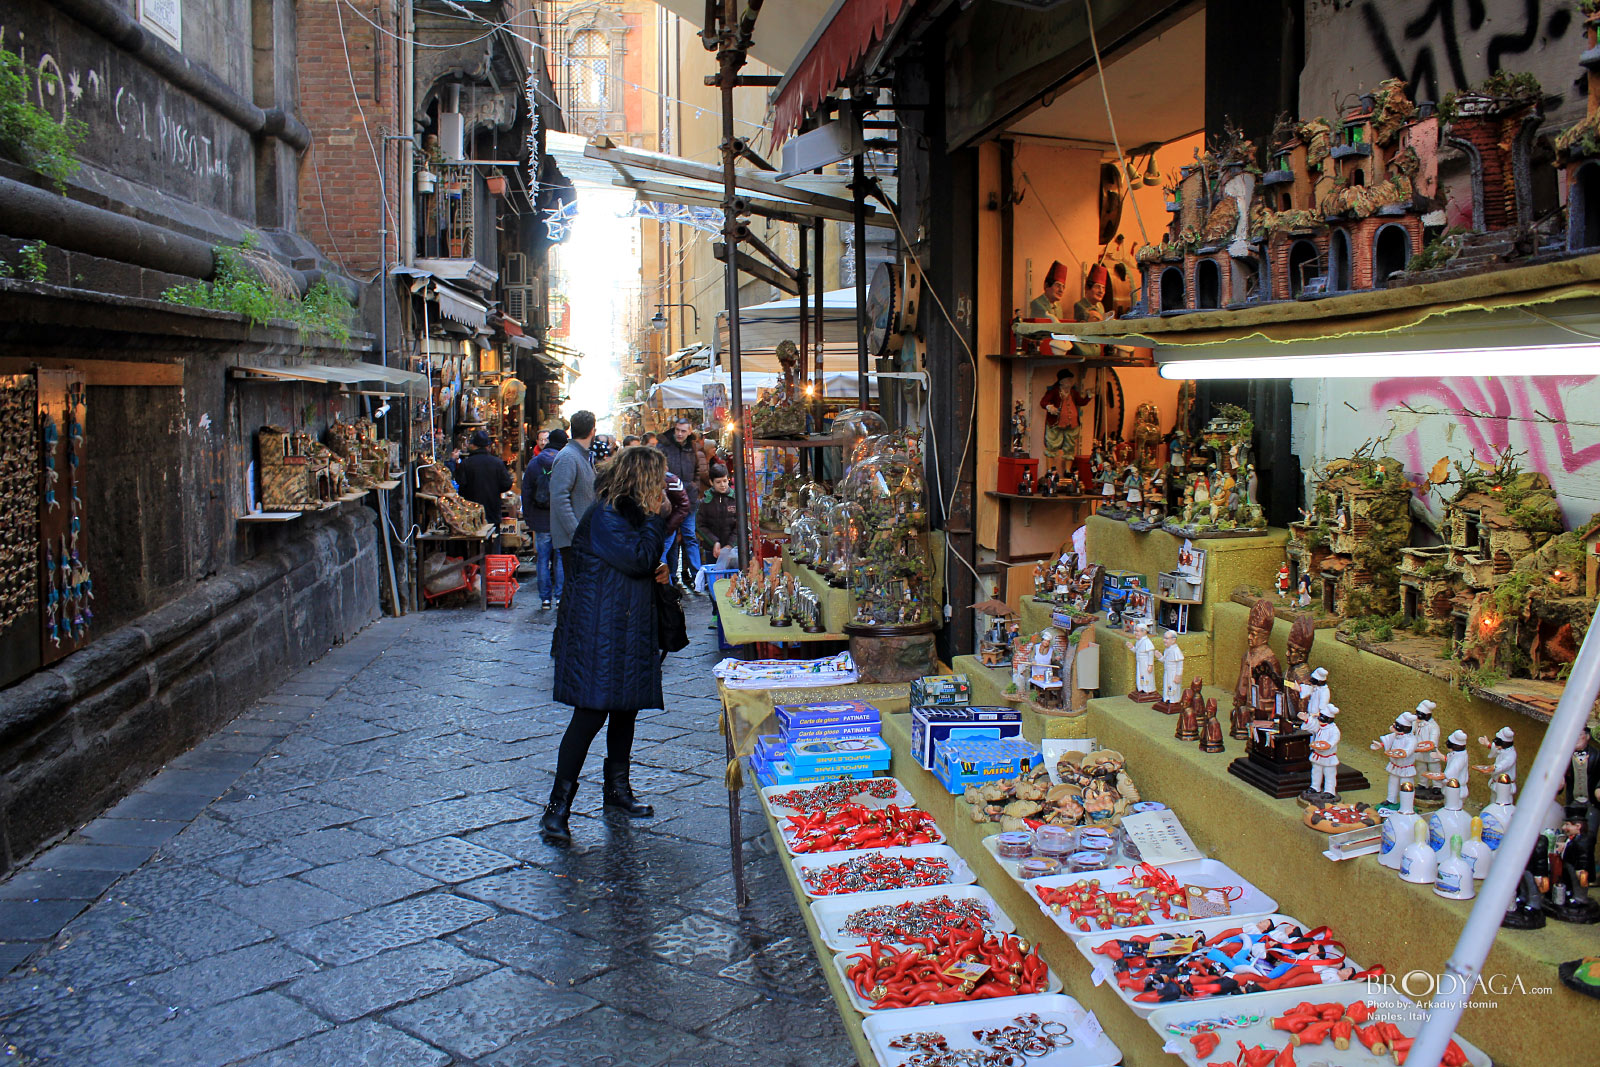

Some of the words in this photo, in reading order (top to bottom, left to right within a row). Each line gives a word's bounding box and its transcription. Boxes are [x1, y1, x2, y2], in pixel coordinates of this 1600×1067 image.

[816, 754, 871, 763] NAPOLETANE
[814, 764, 869, 773] NAPOLETANE
[983, 767, 1014, 776] MINI
